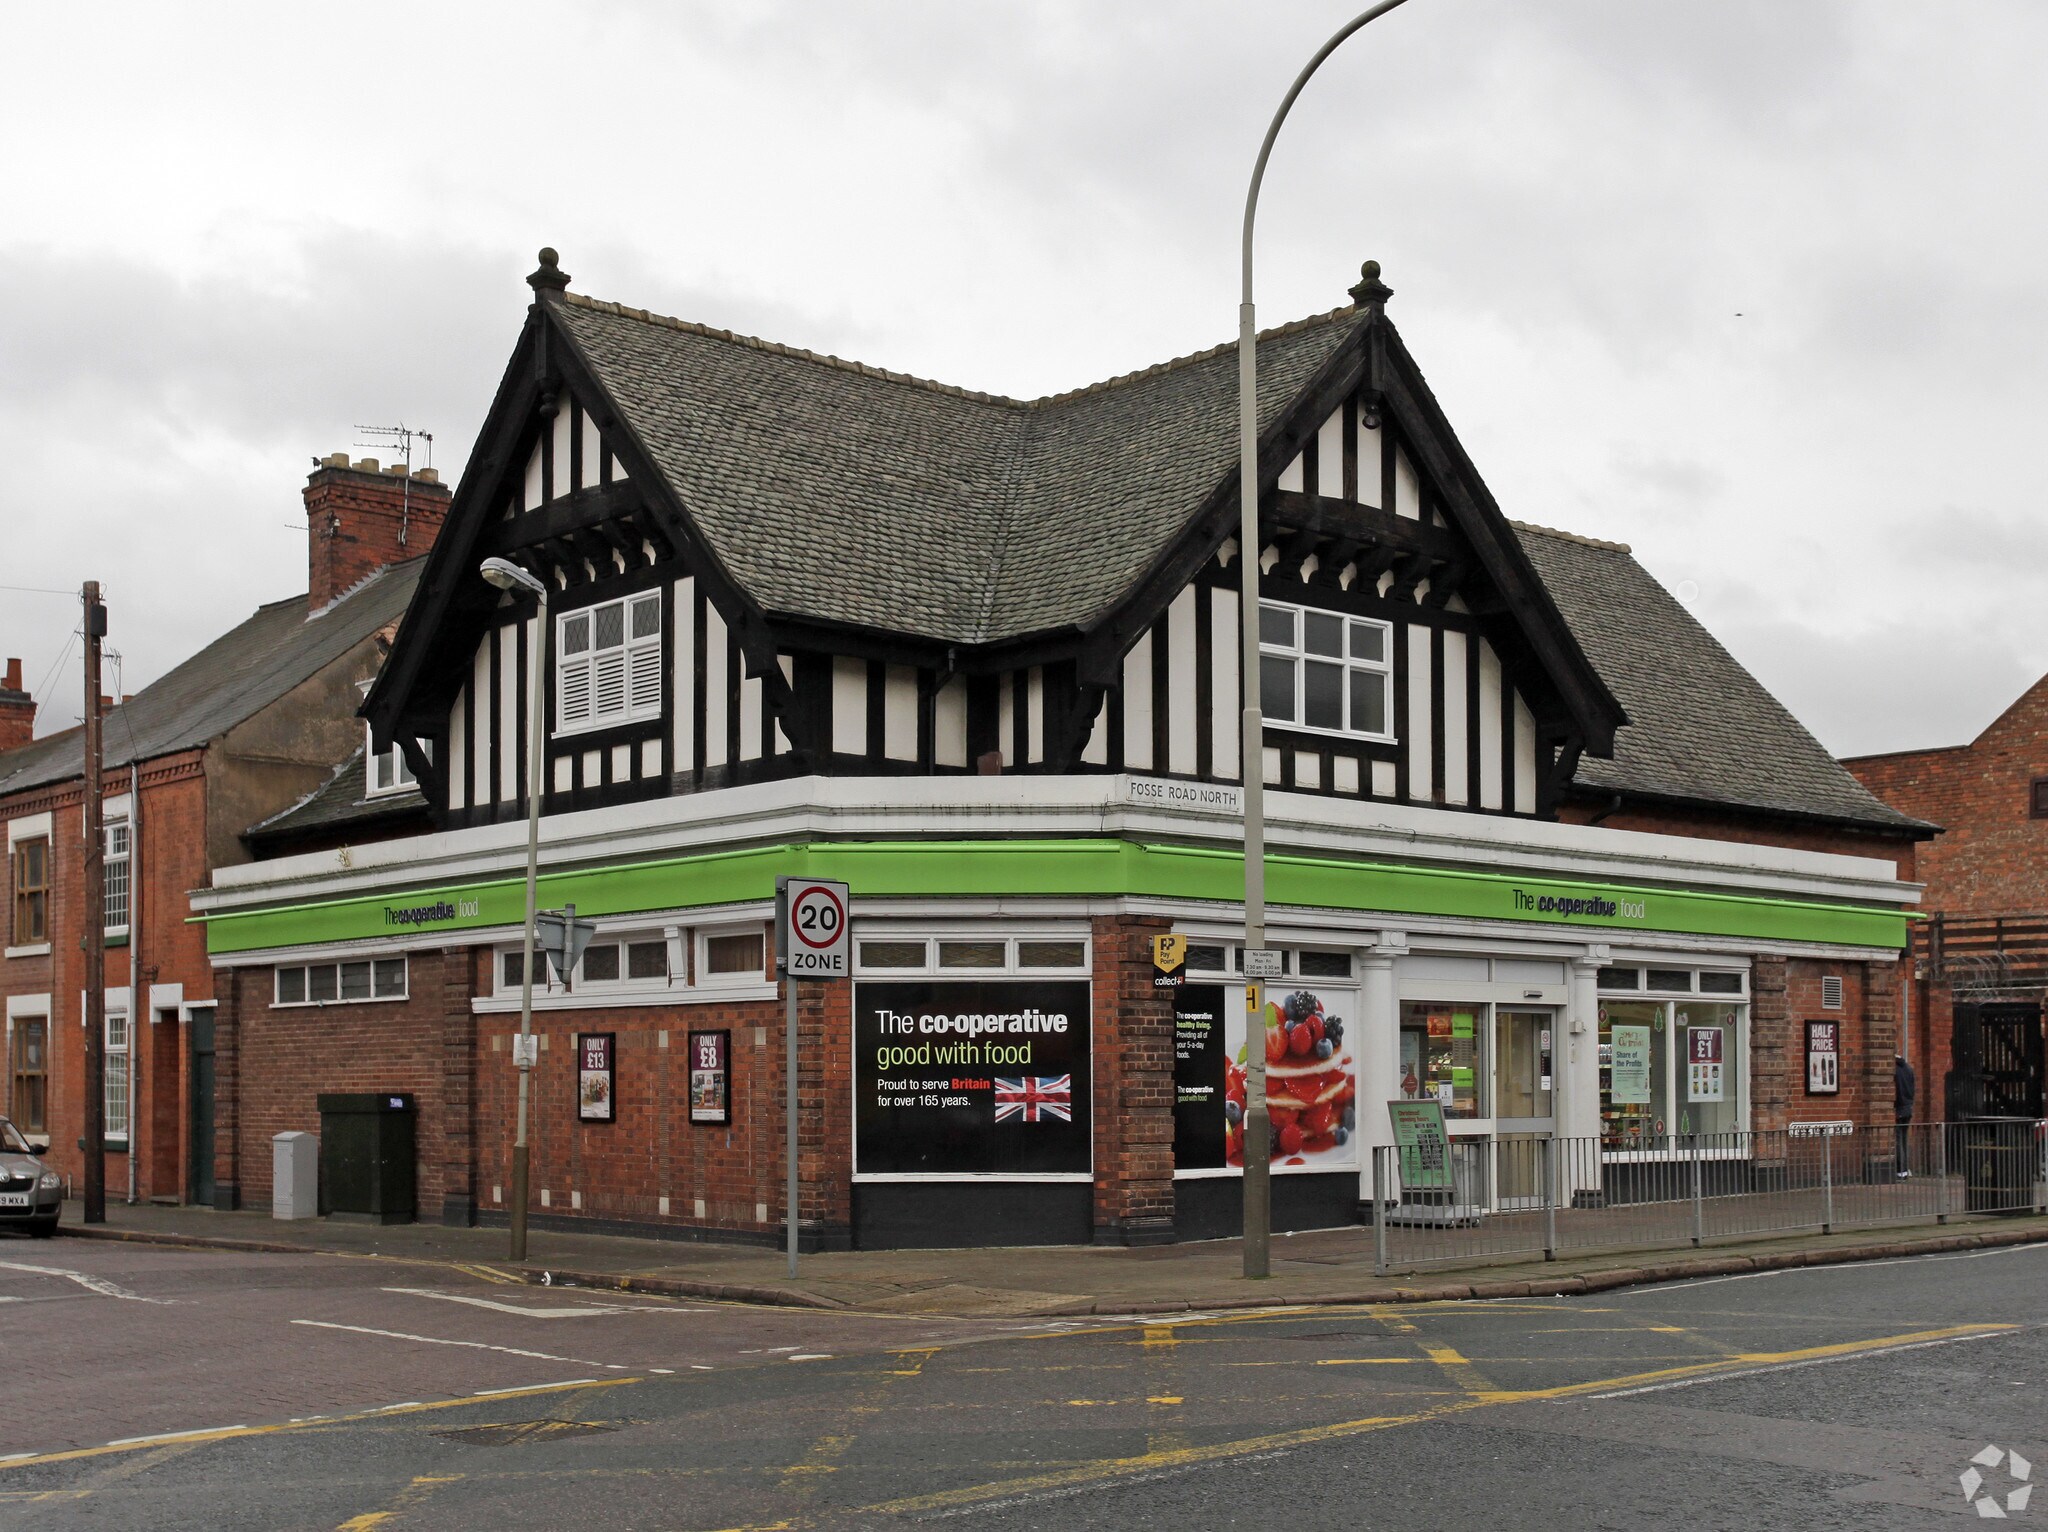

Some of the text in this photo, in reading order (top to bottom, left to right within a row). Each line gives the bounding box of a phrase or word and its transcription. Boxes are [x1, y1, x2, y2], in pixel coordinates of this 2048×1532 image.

[1131, 782, 1237, 805] FOSSE ROAD NORTH
[1513, 889, 1645, 918] The co-operative food
[384, 897, 478, 927] The co-operative food
[801, 905, 837, 930] 20
[794, 953, 842, 969] ZONE
[1176, 1011, 1213, 1021] The co-operative
[875, 1009, 1068, 1038] The co-operative
[1176, 1021, 1195, 1029] healthy
[1176, 1031, 1196, 1040] Providing
[1697, 1030, 1714, 1040] ONLY
[1812, 1025, 1833, 1038] HALF
[587, 1039, 605, 1051] ONLY
[700, 1036, 717, 1047] ONLY
[1187, 1041, 1204, 1049] 5-a-day
[1812, 1039, 1833, 1051] PRICE
[1697, 1040, 1712, 1058] £1
[587, 1052, 604, 1068] £13
[700, 1047, 717, 1068] £8
[877, 1041, 1031, 1070] good with food
[1626, 1059, 1642, 1067] Profits
[877, 1078, 990, 1090] Proud to serve Britain
[1185, 1086, 1214, 1094] co-operative
[878, 1095, 971, 1108] for over 165 years.
[1178, 1095, 1188, 1103] good
[0, 1196, 25, 1205] 9 MXA
